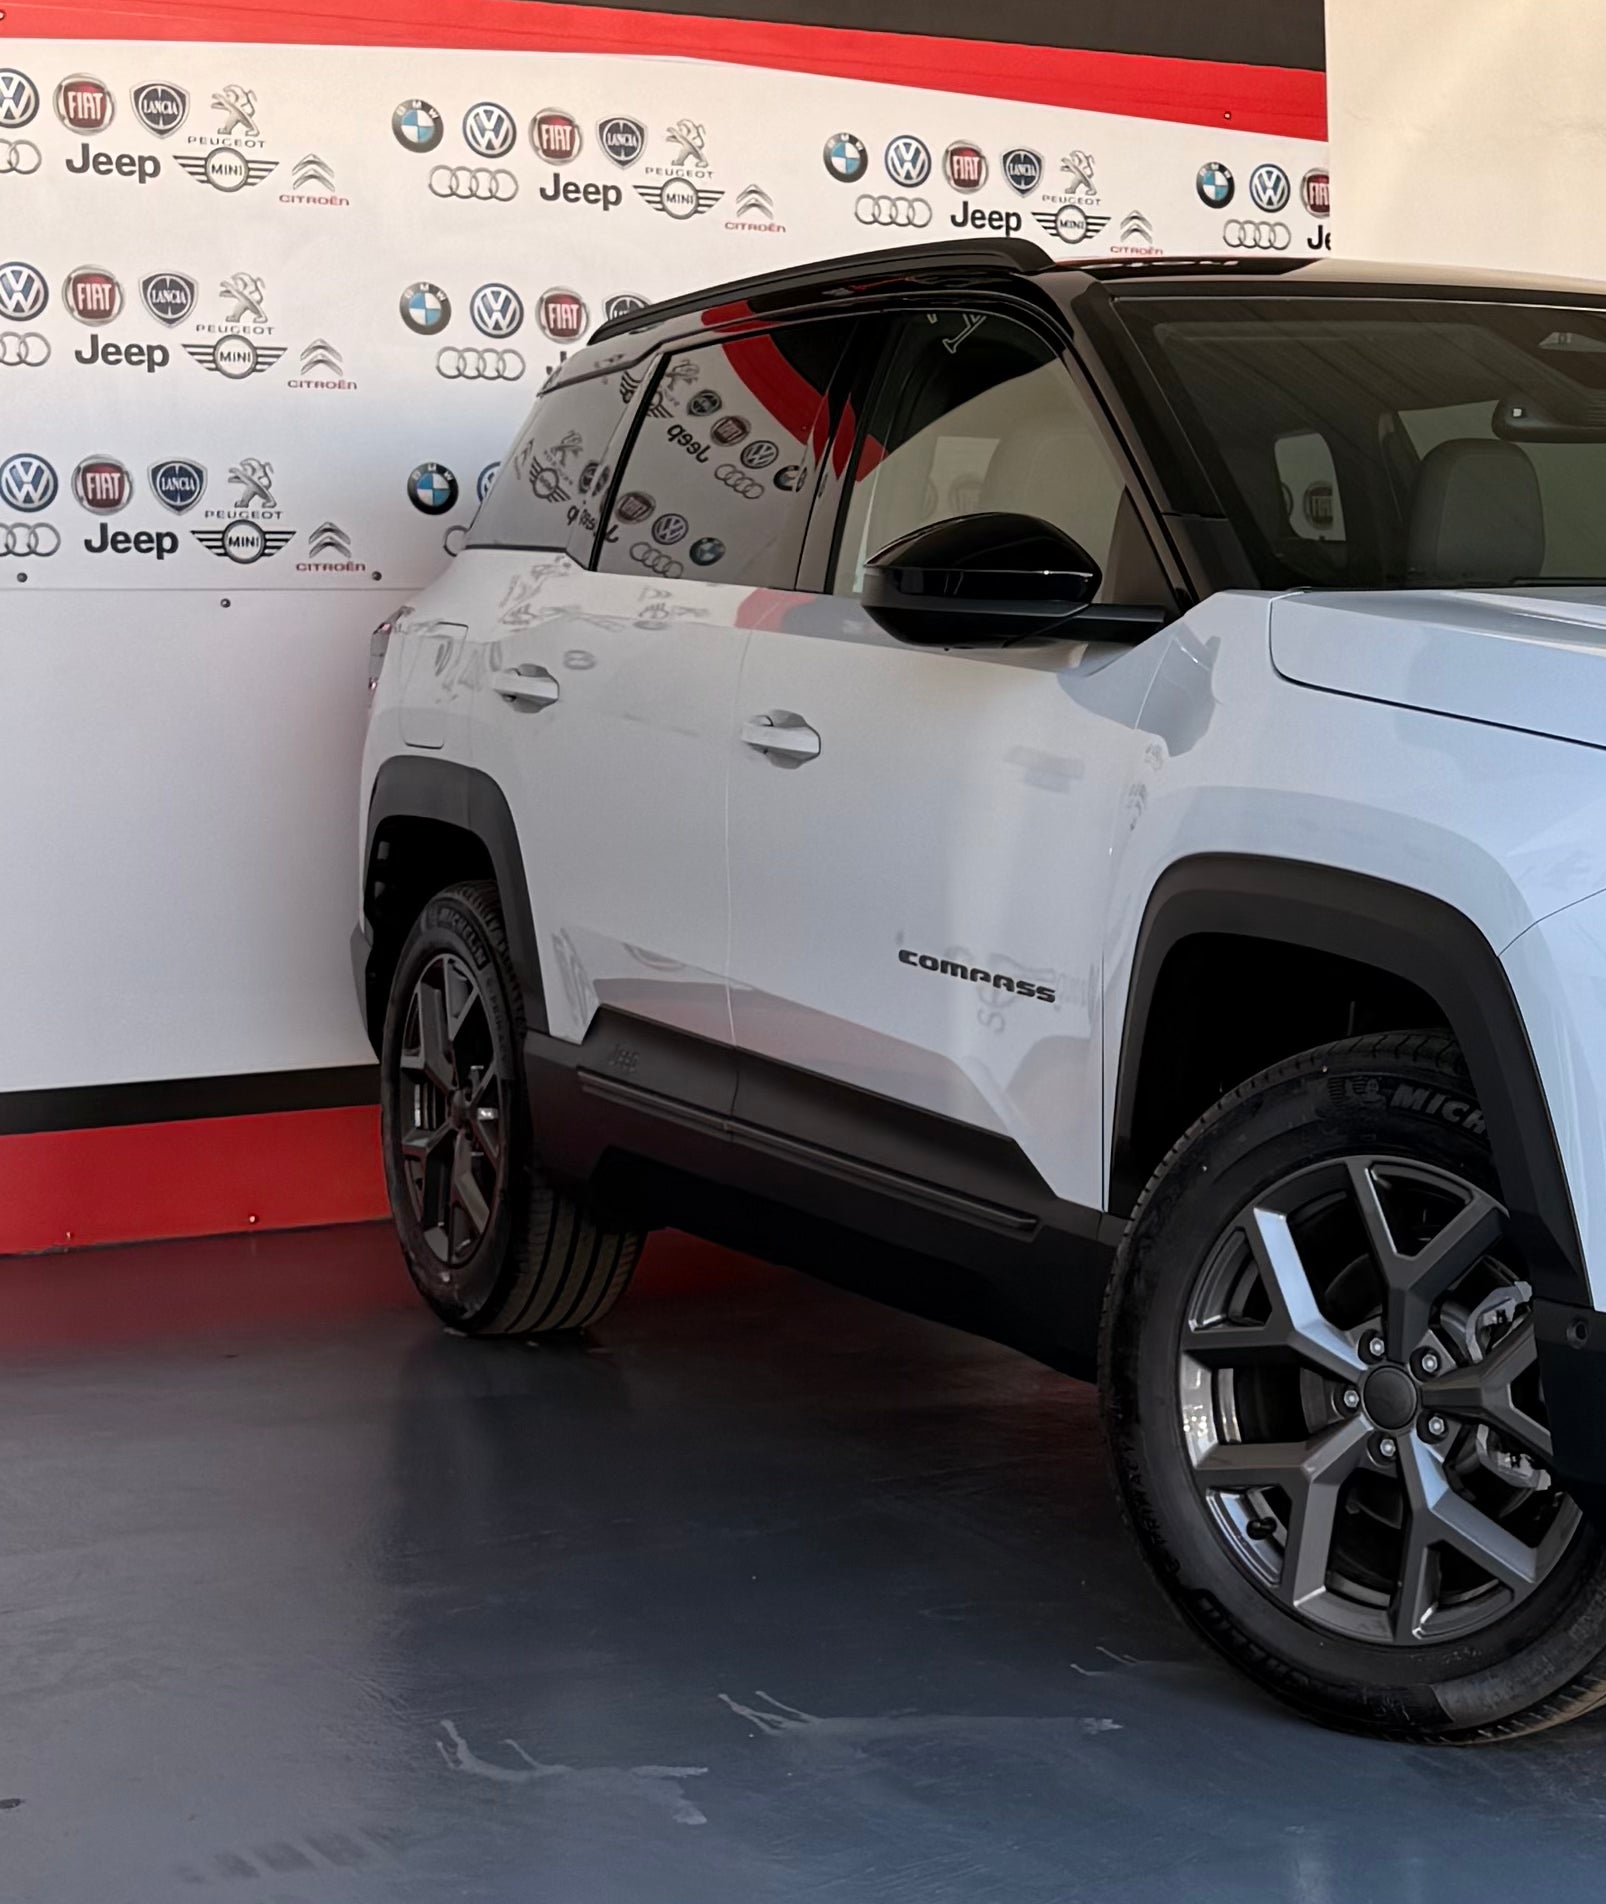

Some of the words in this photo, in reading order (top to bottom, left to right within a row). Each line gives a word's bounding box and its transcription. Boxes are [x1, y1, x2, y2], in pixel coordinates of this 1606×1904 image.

[67, 91, 104, 120] FIAT
[143, 99, 178, 116] LANCIA
[187, 136, 266, 149] PEUGEOT
[542, 123, 572, 152] FIAT
[606, 131, 638, 149] LANCIA
[65, 143, 161, 184] Jeep
[210, 163, 243, 177] MINI
[952, 155, 979, 181] FIAT
[644, 167, 716, 179] PEUGEOT
[539, 173, 623, 211] Jeep
[665, 192, 694, 206] MINI
[1041, 195, 1102, 206] PEUGEOT
[950, 200, 1023, 237] Jeep
[76, 283, 113, 311] FIAT
[151, 289, 187, 305] LANCIA
[548, 303, 579, 330] FIAT
[195, 324, 275, 336] PEUGEOT
[74, 334, 170, 373] Jeep
[219, 350, 252, 364] MINI
[86, 471, 122, 500] FIAT
[160, 475, 197, 492] LANCIA
[204, 510, 284, 521] PEUGEOT
[84, 522, 179, 560] Jeep
[227, 535, 261, 549] MINI
[898, 949, 1056, 1003] COMPASS
